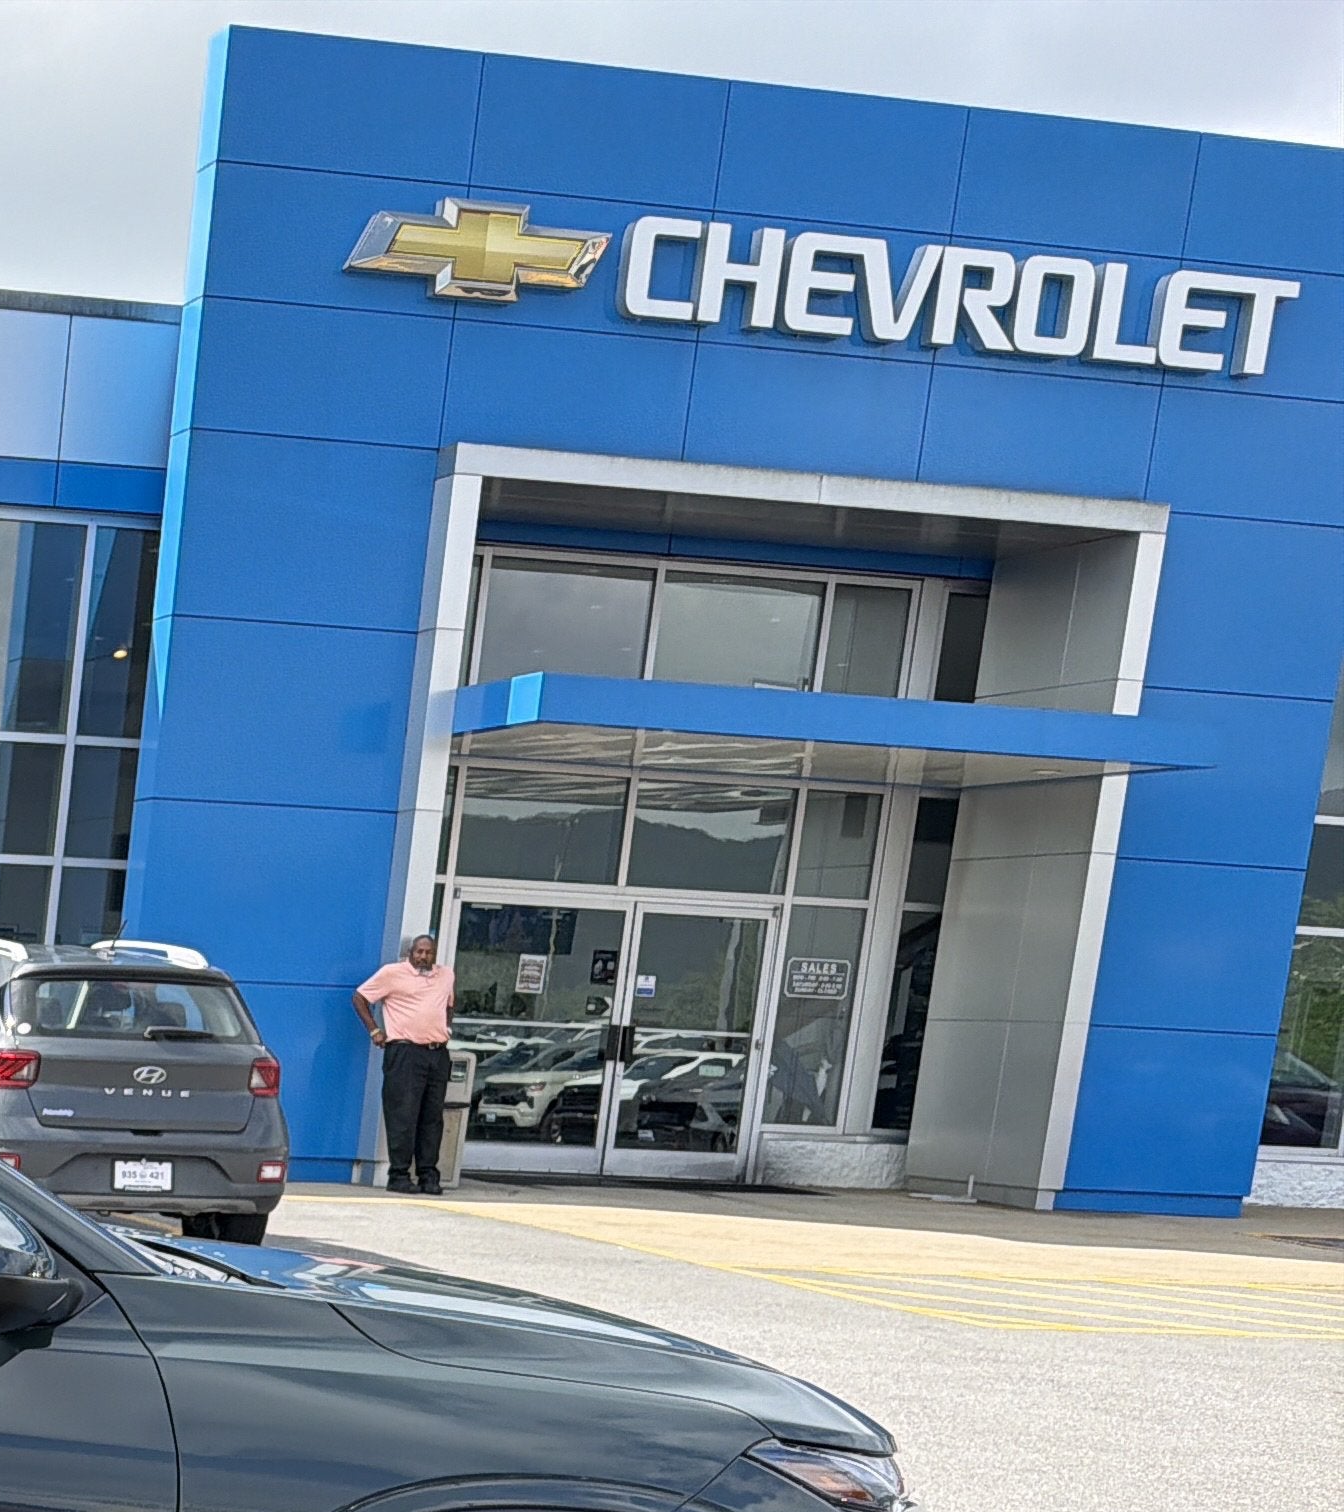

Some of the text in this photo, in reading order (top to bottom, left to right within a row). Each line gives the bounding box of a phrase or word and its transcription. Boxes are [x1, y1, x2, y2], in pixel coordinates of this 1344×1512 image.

[622, 214, 1301, 376] CHEVROLET
[800, 961, 838, 975] SALES
[104, 1087, 191, 1098] VENUE
